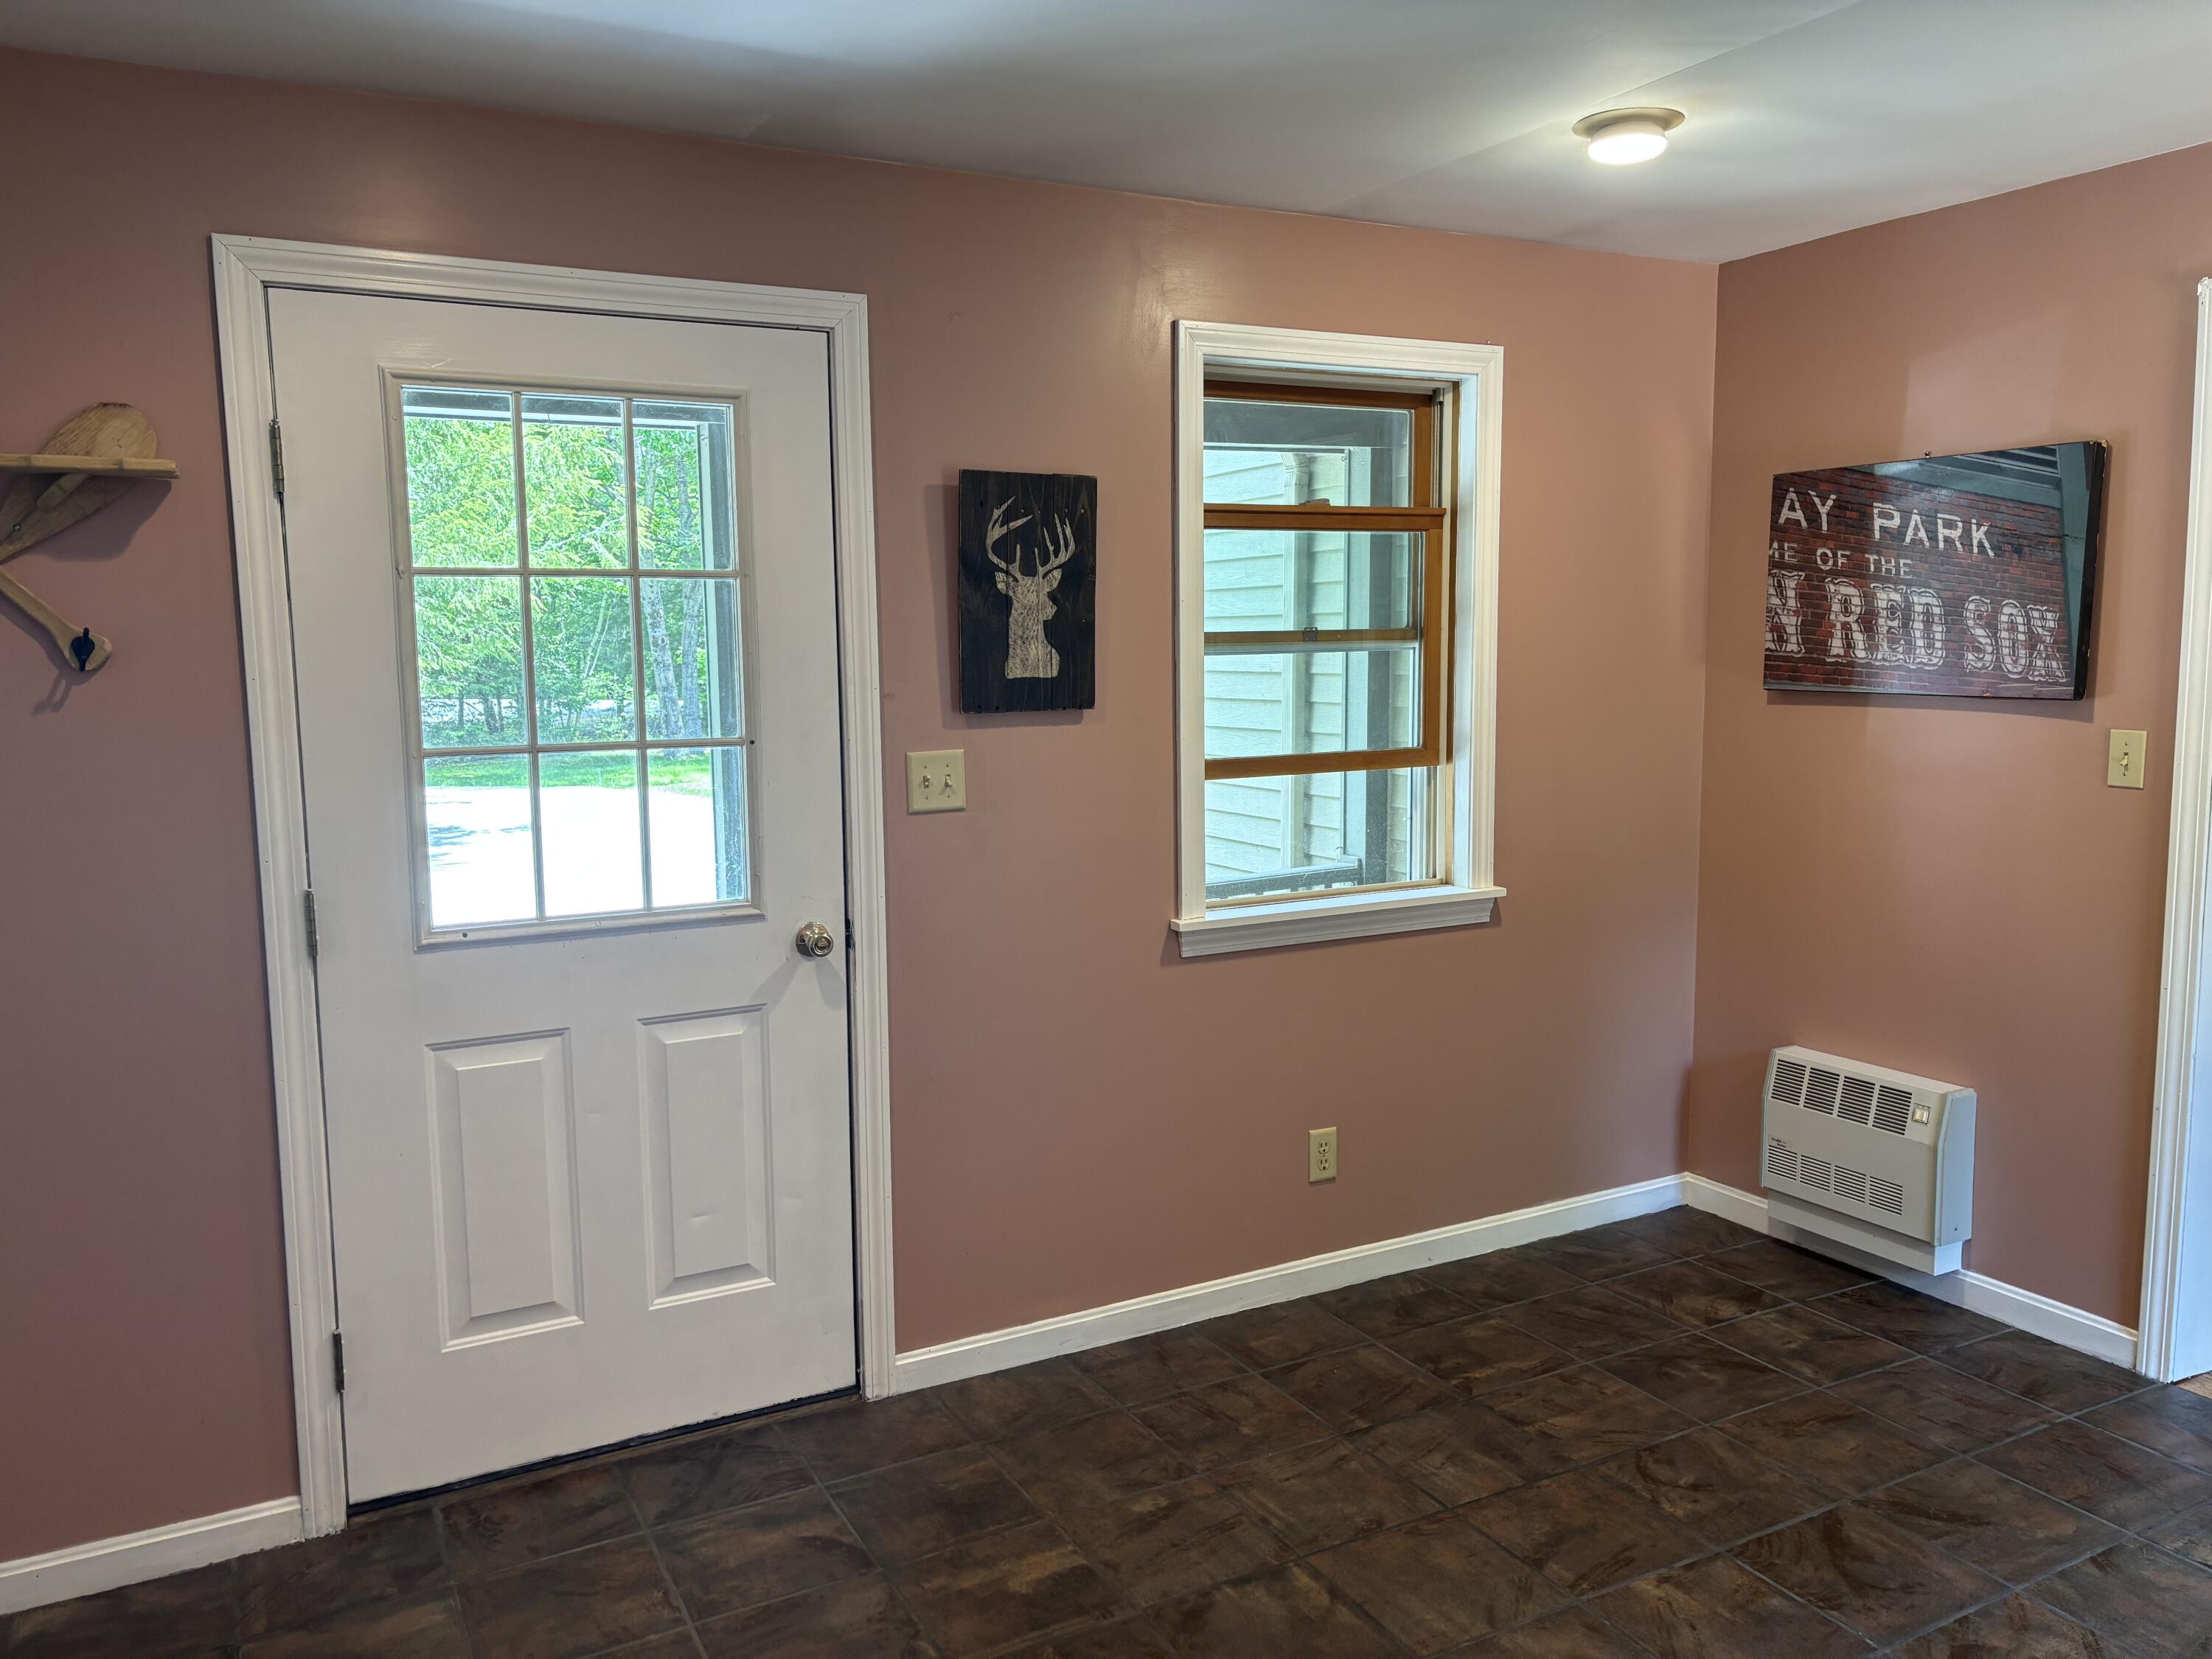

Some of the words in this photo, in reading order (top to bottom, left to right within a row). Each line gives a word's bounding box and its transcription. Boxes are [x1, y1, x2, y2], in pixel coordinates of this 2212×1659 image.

[1778, 487, 1837, 533] AY
[1874, 502, 1994, 558] PARK
[1816, 548, 1851, 570] OF
[1865, 554, 1913, 579] THE
[1825, 577, 1947, 670] RED
[1964, 596, 2068, 681] SOX
